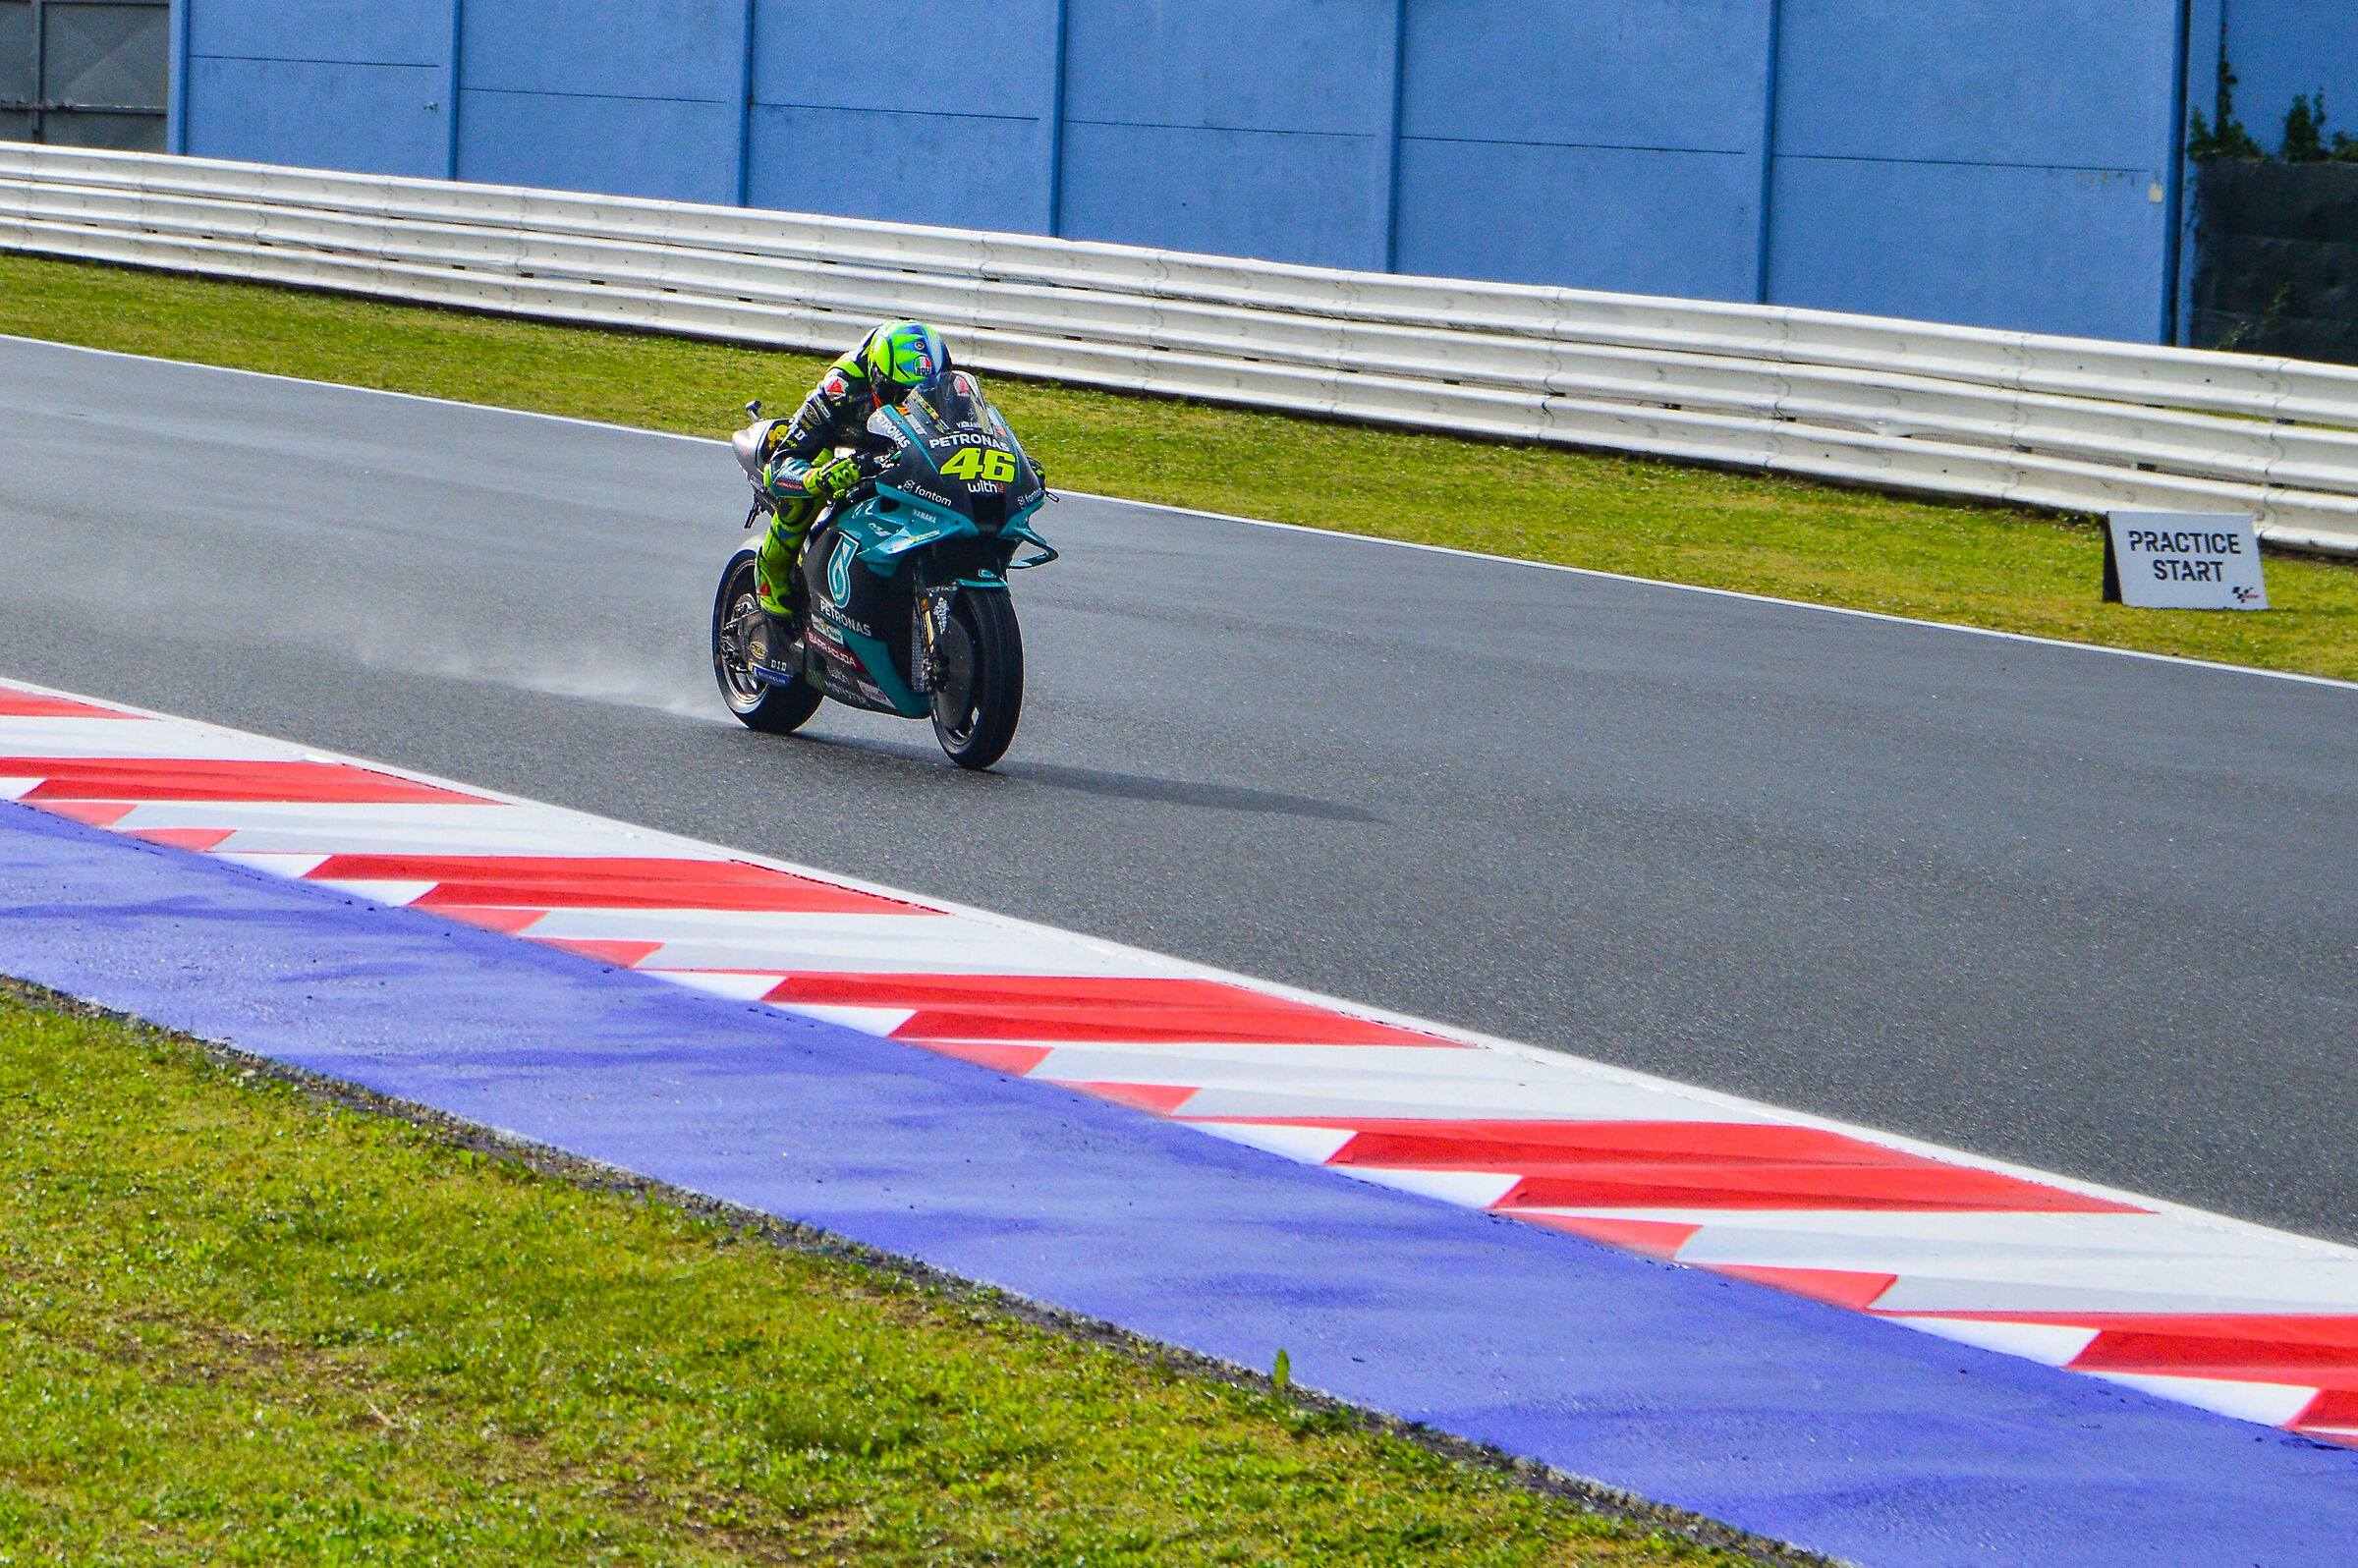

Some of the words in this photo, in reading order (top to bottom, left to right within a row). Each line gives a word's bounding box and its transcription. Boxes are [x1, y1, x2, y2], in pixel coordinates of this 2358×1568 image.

[873, 411, 911, 448] PETRONAS
[929, 432, 1010, 452] PETRONAS
[939, 447, 1016, 482] 46
[914, 484, 952, 507] fantom
[2128, 531, 2241, 554] PRACTICE
[2153, 559, 2223, 582] START
[819, 598, 871, 637] PETRONAS
